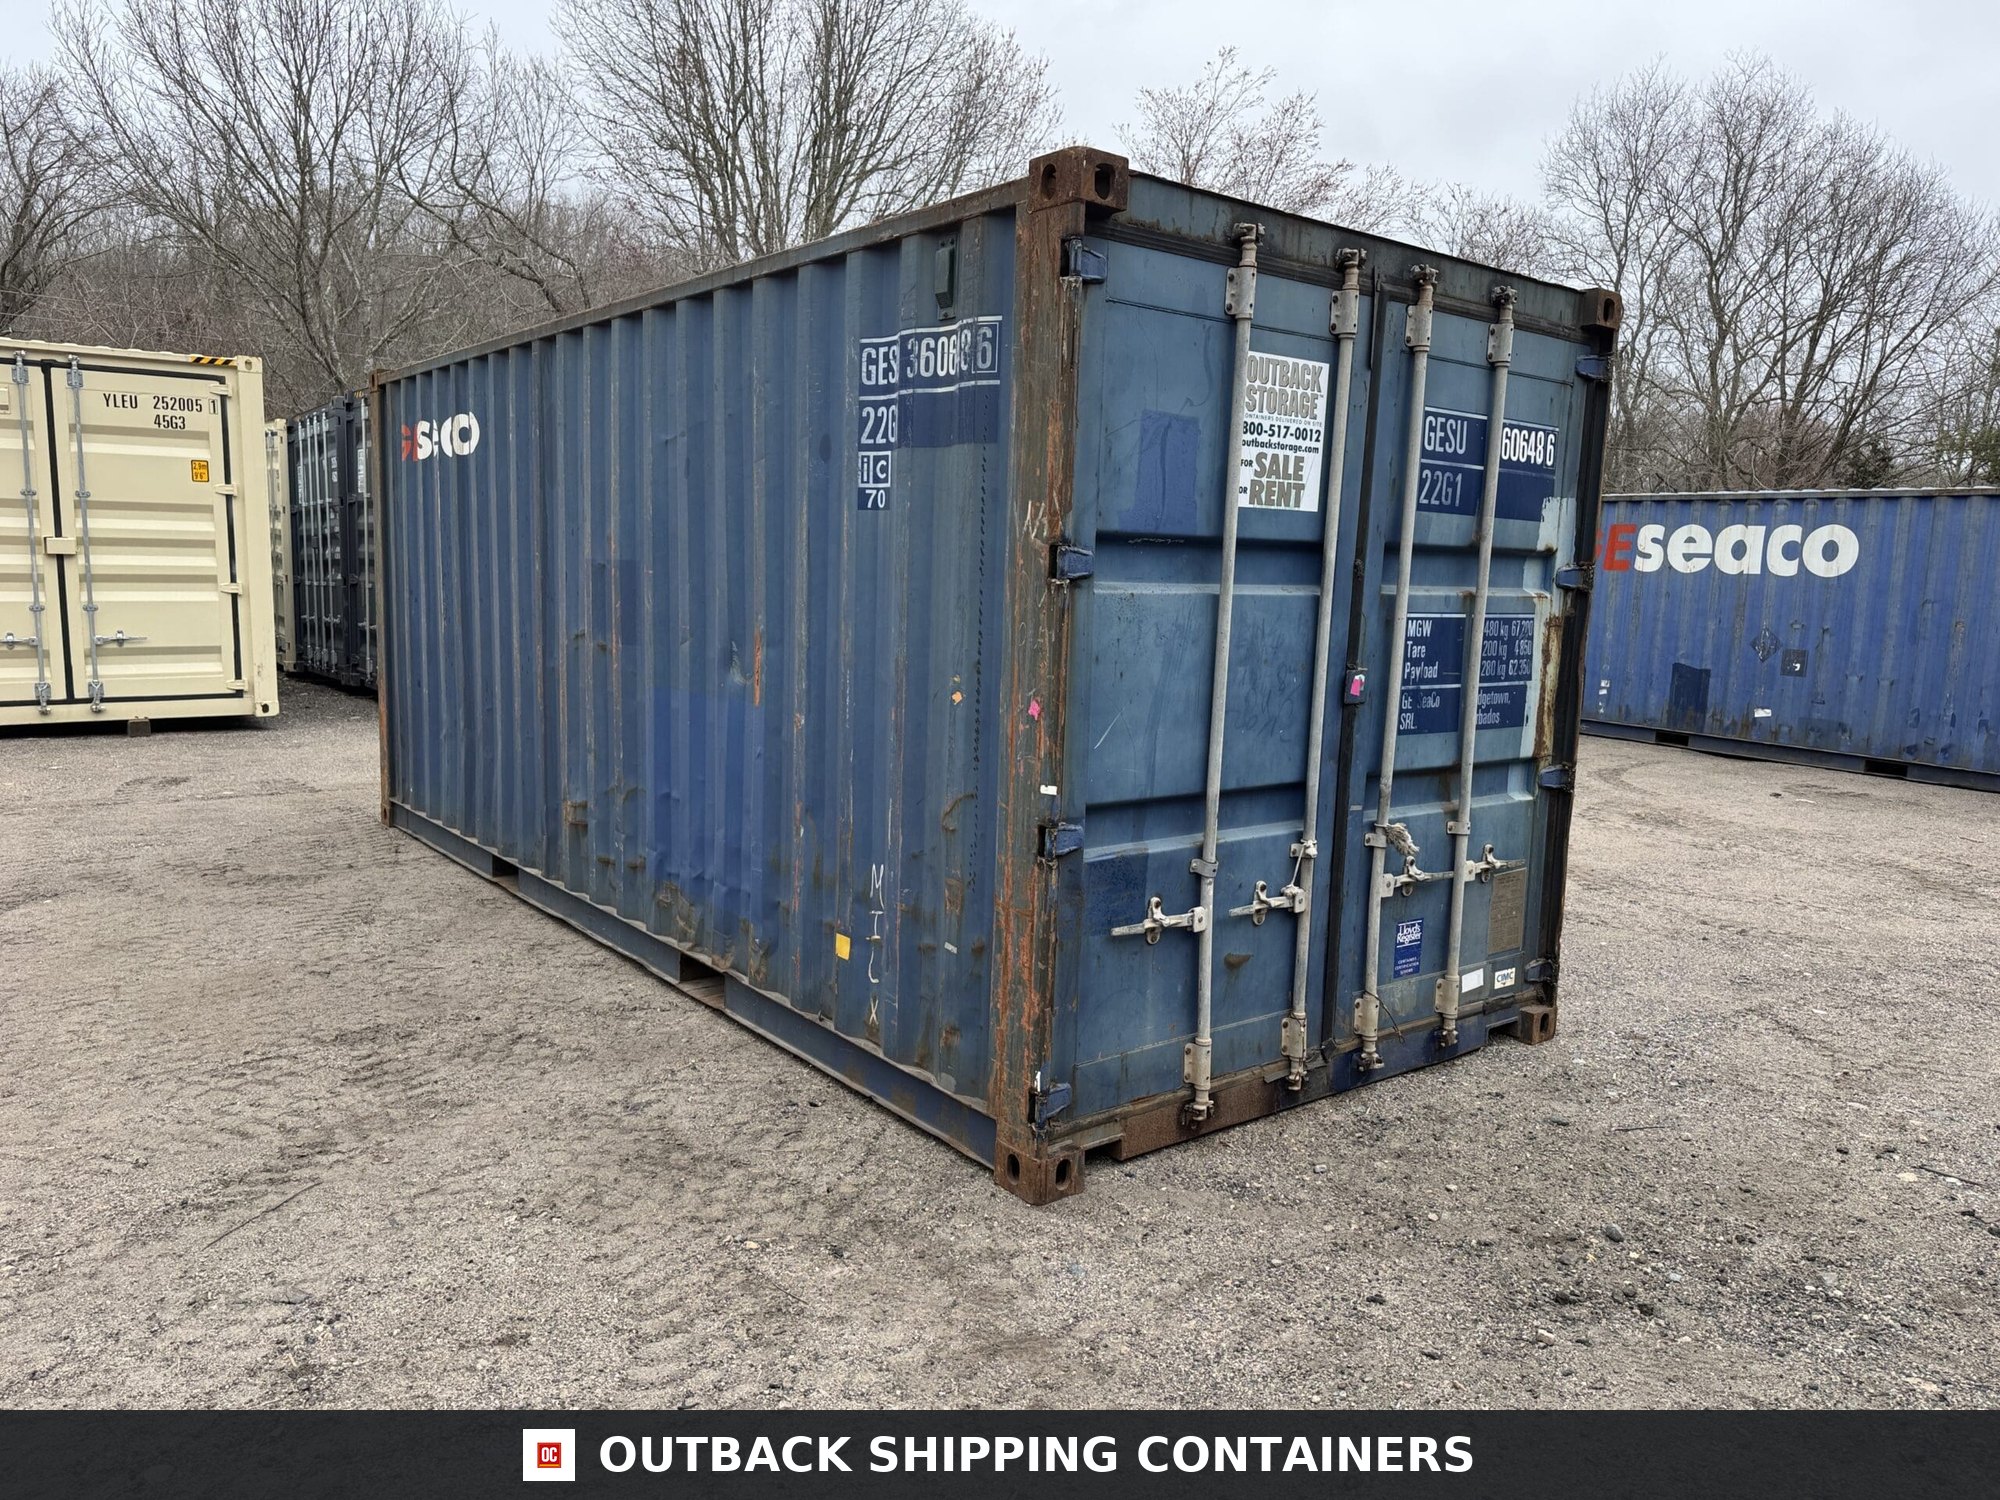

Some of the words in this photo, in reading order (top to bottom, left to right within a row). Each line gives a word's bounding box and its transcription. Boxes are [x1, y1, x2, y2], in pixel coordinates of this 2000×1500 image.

[861, 343, 899, 386] GES
[1246, 355, 1323, 393] OUTBACK
[103, 393, 138, 409] YLEU
[153, 395, 203, 413] 252005
[1245, 385, 1319, 421] STORAGE
[154, 414, 186, 430] 45G3
[861, 405, 898, 445] 22G
[1245, 413, 1274, 422] ONTAINERS
[1242, 437, 1319, 454] outbackstorage.com
[1424, 415, 1467, 455] GESU
[1501, 427, 1544, 465] 60648
[1240, 458, 1253, 468] FOR
[1253, 451, 1305, 481] SALE
[865, 489, 886, 508] 70
[1238, 485, 1248, 494] OR
[1248, 479, 1306, 508] RENT
[1418, 469, 1463, 508] 22G1
[1407, 619, 1433, 638] MGW
[1500, 619, 1509, 640] kg
[1407, 641, 1426, 659] Tare
[1499, 639, 1508, 660] kg
[1404, 661, 1439, 683] Payload
[1497, 660, 1506, 680] kg
[1478, 708, 1500, 725] bados
